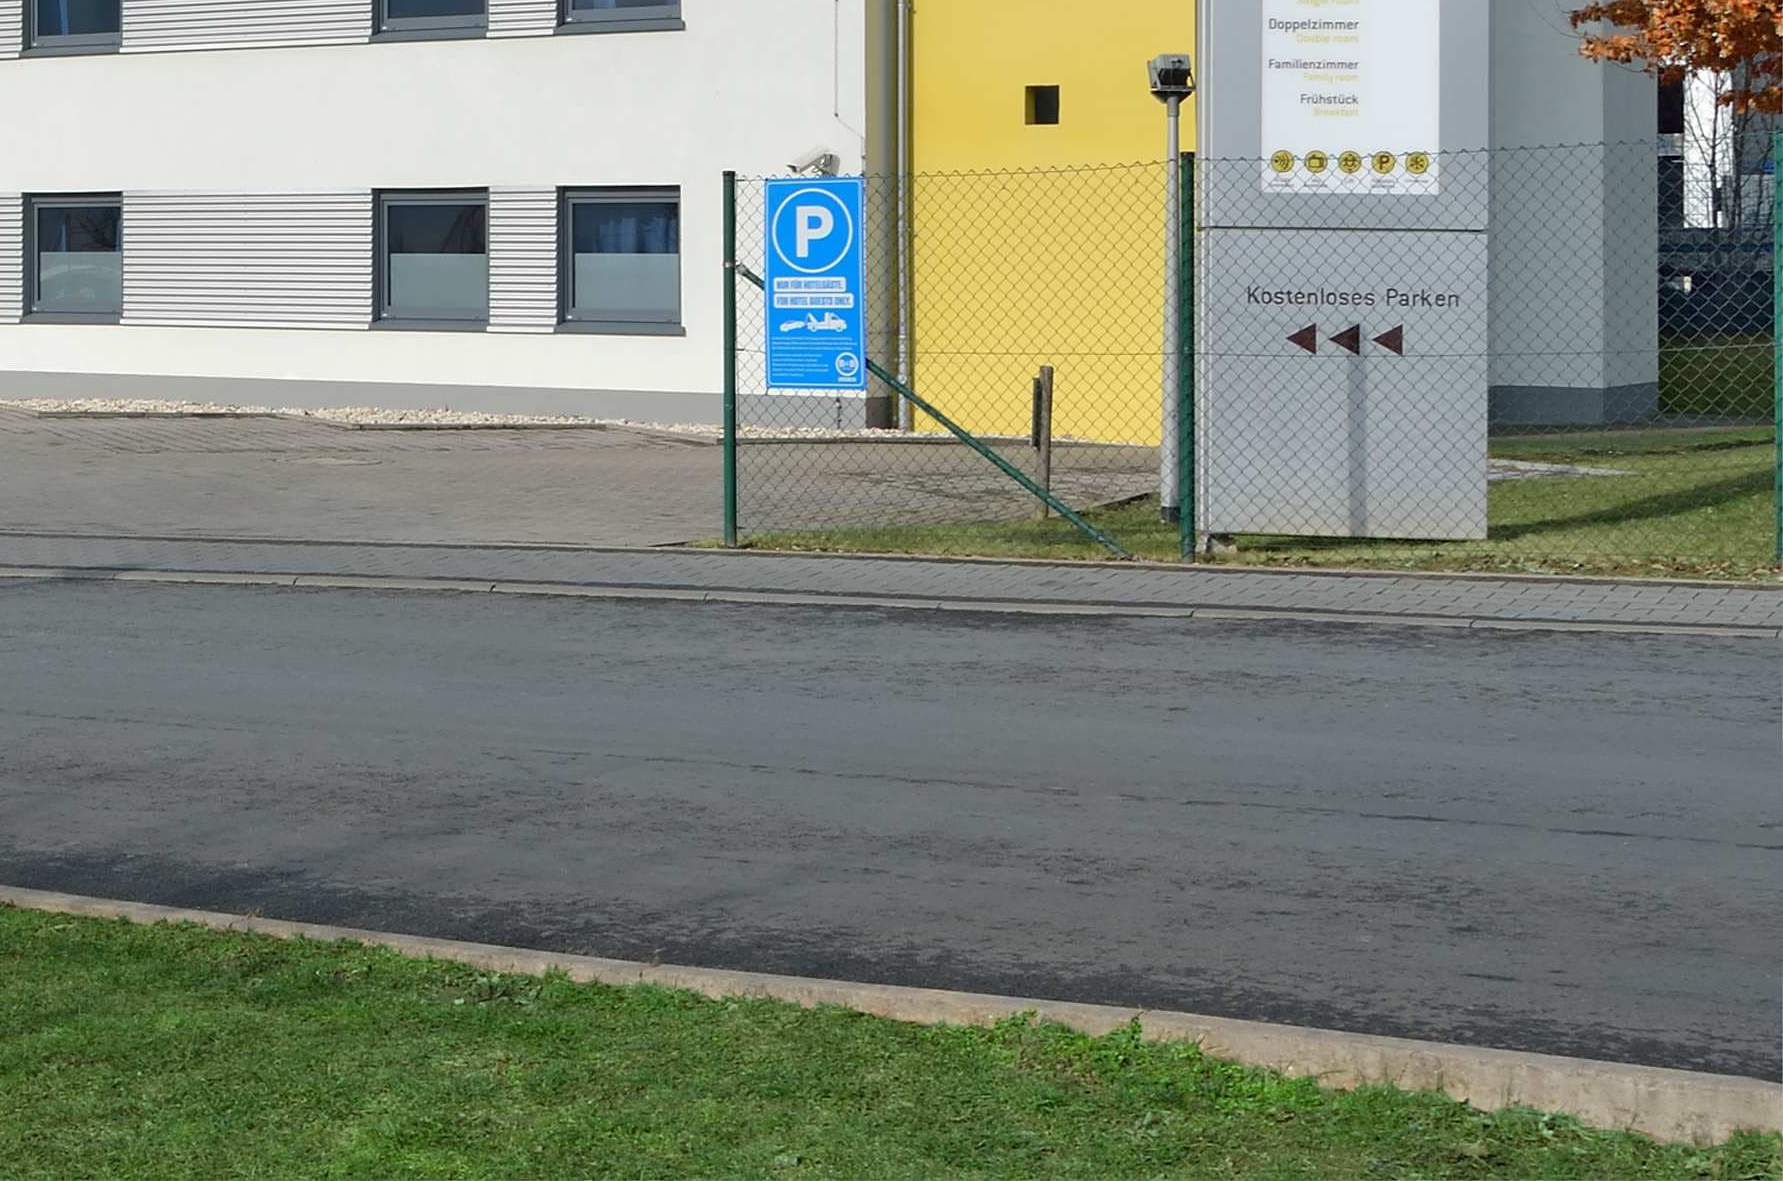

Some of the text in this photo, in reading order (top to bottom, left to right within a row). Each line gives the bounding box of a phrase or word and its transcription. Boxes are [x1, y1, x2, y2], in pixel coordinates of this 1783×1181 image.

[1269, 19, 1359, 32] Doppelzimmer
[1296, 34, 1330, 43] Double
[1268, 59, 1359, 69] Familienzimmer
[1300, 93, 1359, 104] Frühstück
[796, 206, 834, 258] P
[1247, 286, 1460, 308] Kostenloses Parken
